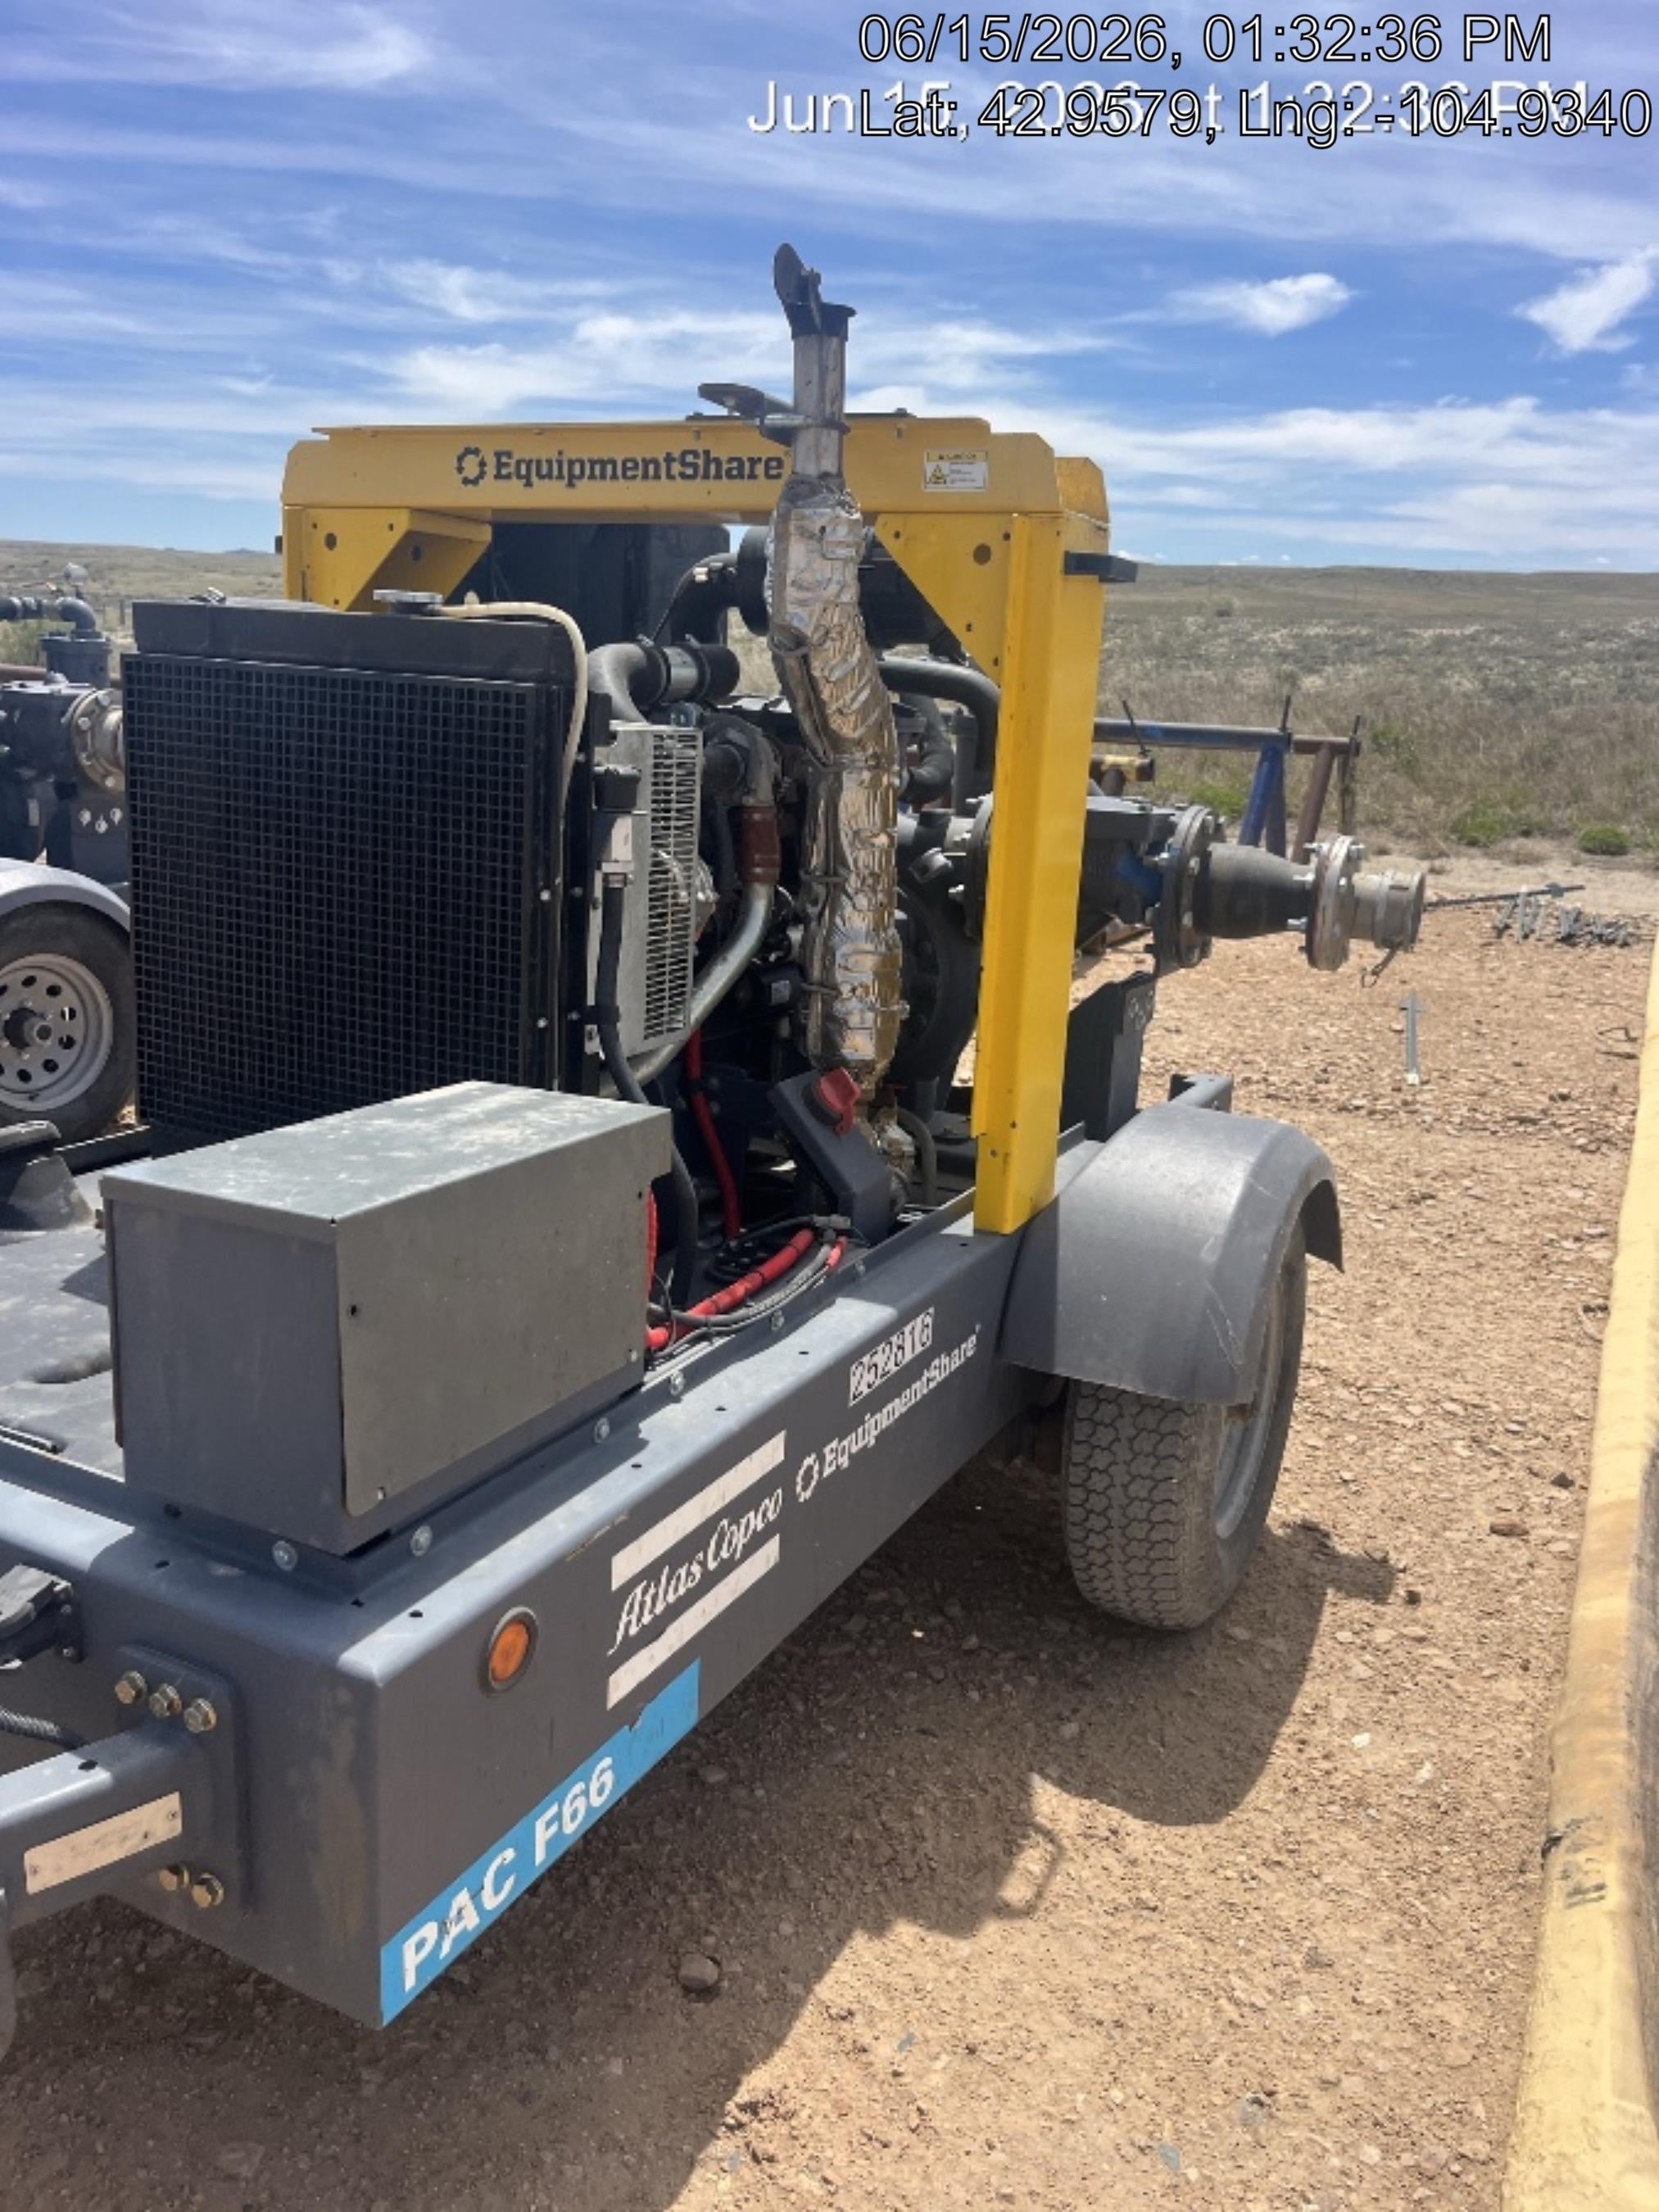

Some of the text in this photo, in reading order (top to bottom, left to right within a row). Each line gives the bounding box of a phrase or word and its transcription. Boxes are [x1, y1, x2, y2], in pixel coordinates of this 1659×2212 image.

[493, 449, 785, 488] EquipmentShare
[822, 1334, 977, 1479] EquipmentShare
[851, 1311, 932, 1402] 252816
[607, 1488, 782, 1657] Atlas Copco
[402, 1756, 614, 1992] PAC F66
